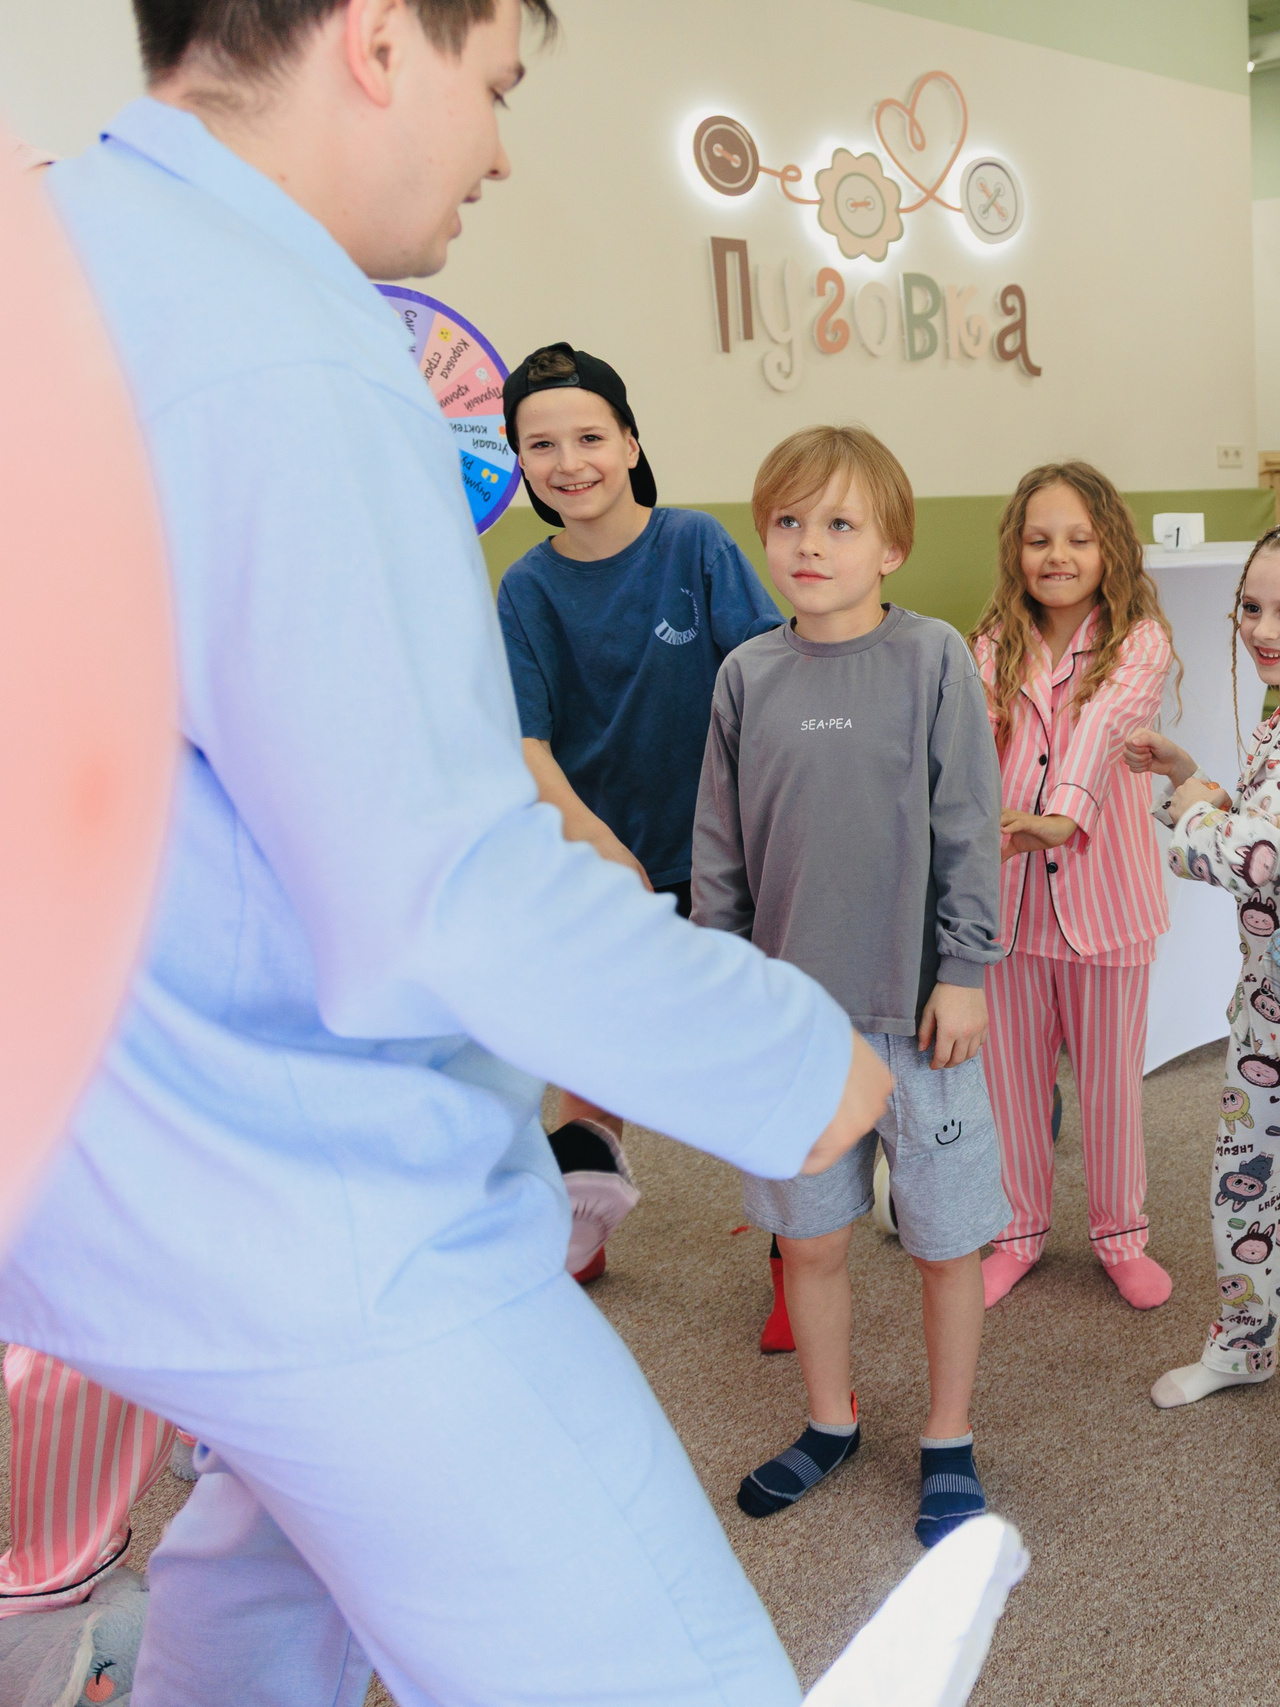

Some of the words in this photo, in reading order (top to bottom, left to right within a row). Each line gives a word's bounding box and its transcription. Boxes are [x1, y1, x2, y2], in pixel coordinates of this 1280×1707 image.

[424, 351, 442, 384] страх
[441, 339, 470, 380] Коробка
[465, 386, 503, 412] Пухлый
[449, 423, 488, 435] коктей
[472, 438, 509, 455] Угадай
[463, 473, 491, 503] Очуме
